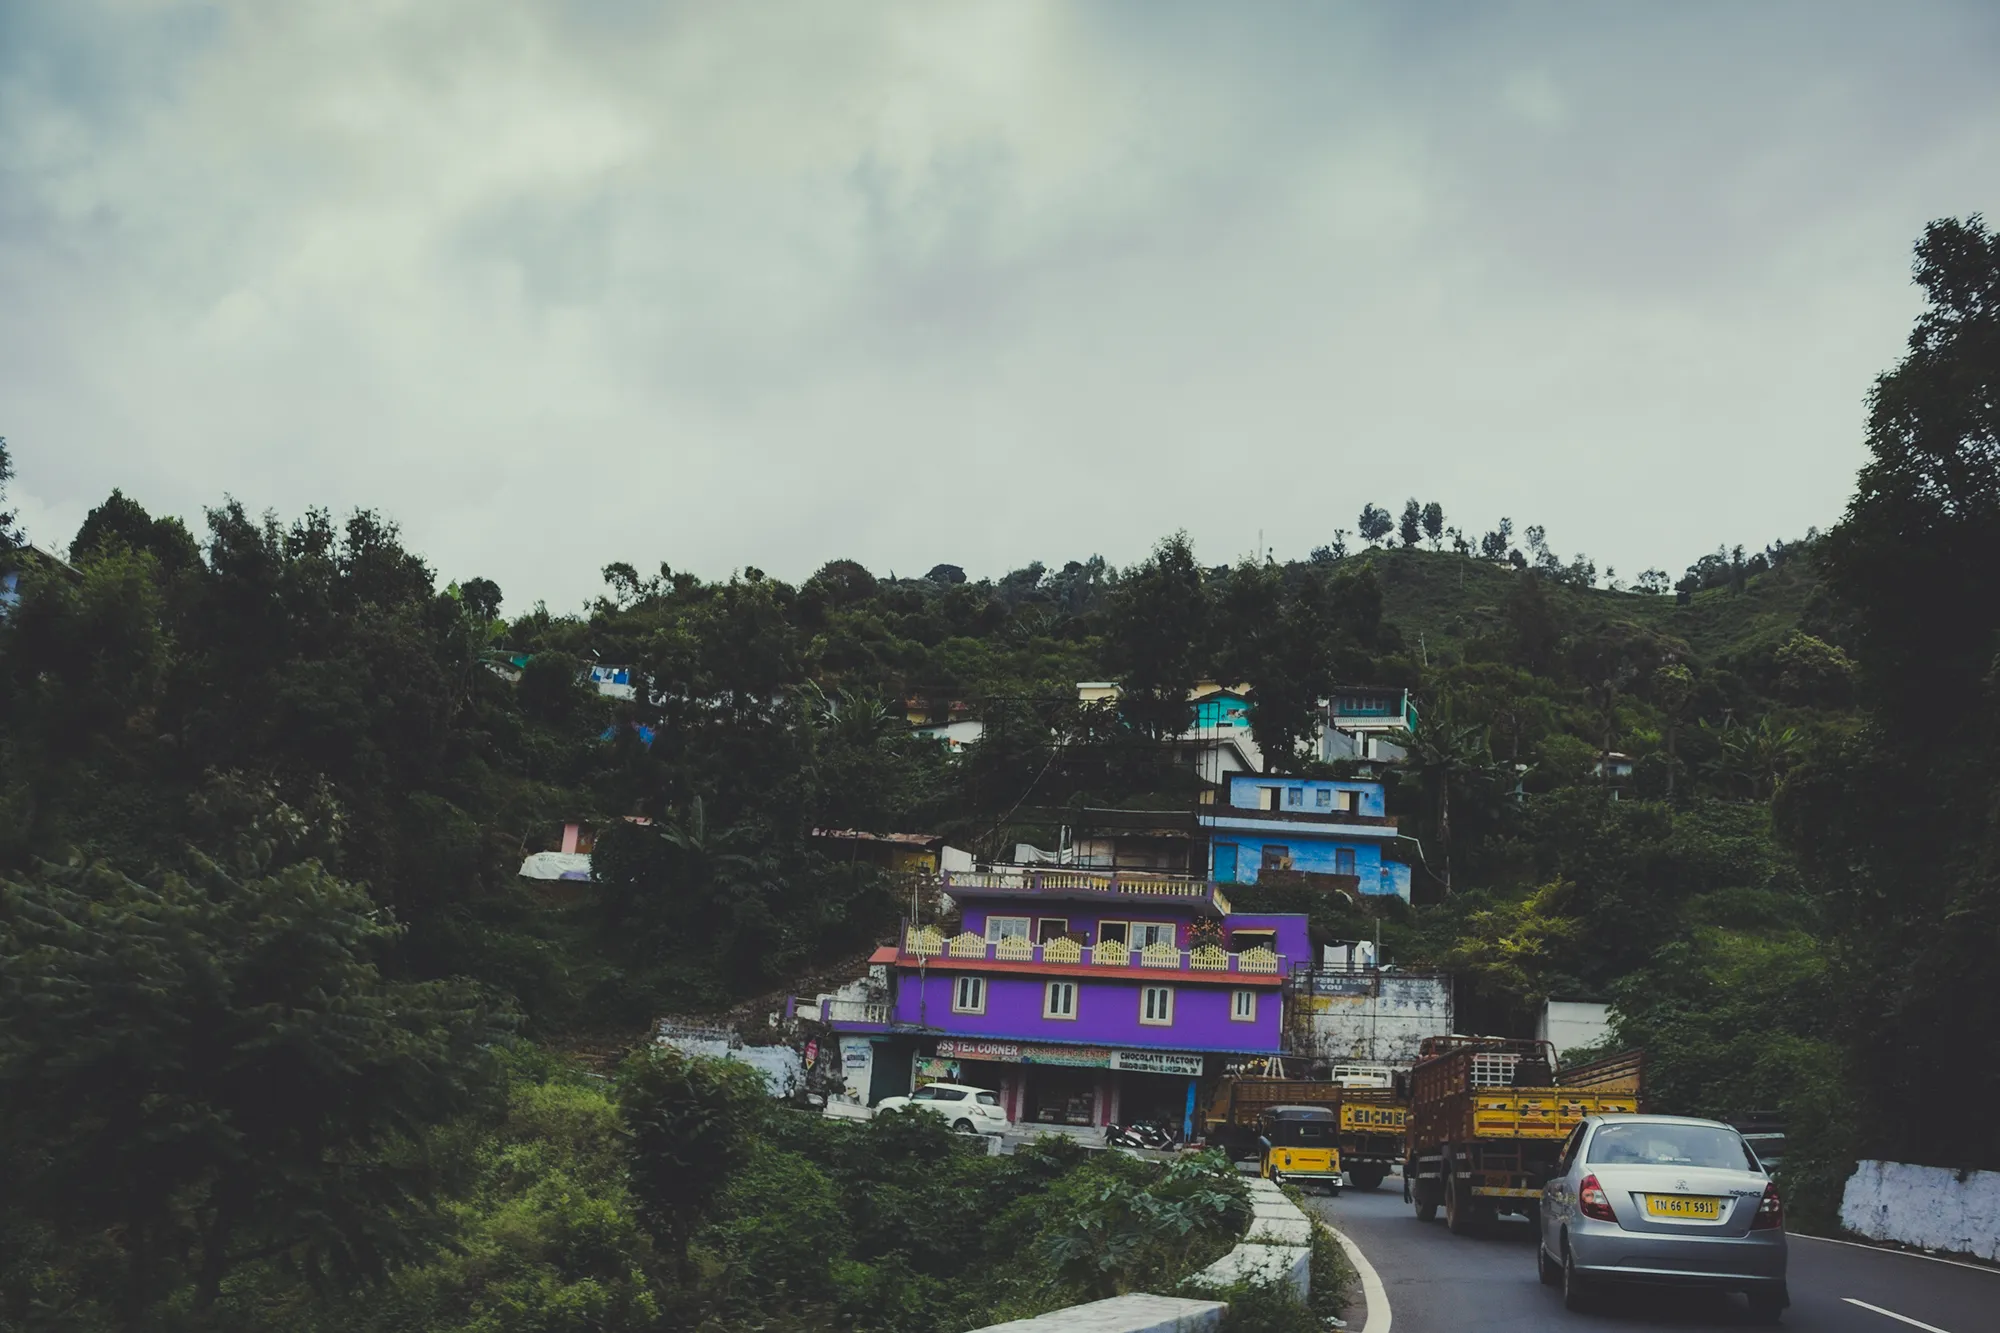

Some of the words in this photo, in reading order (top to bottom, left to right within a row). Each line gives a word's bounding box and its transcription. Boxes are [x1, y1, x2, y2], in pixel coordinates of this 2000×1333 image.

[937, 1040, 954, 1051] JSS
[957, 1042, 975, 1053] TEA
[978, 1043, 1018, 1056] CORNER
[1120, 1052, 1163, 1064] CHOCOLATE
[1166, 1055, 1201, 1066] FACTORY
[1655, 1200, 1667, 1210] TN
[1671, 1201, 1682, 1211] 66
[1685, 1201, 1691, 1211] T
[1694, 1202, 1713, 1213] 5911
